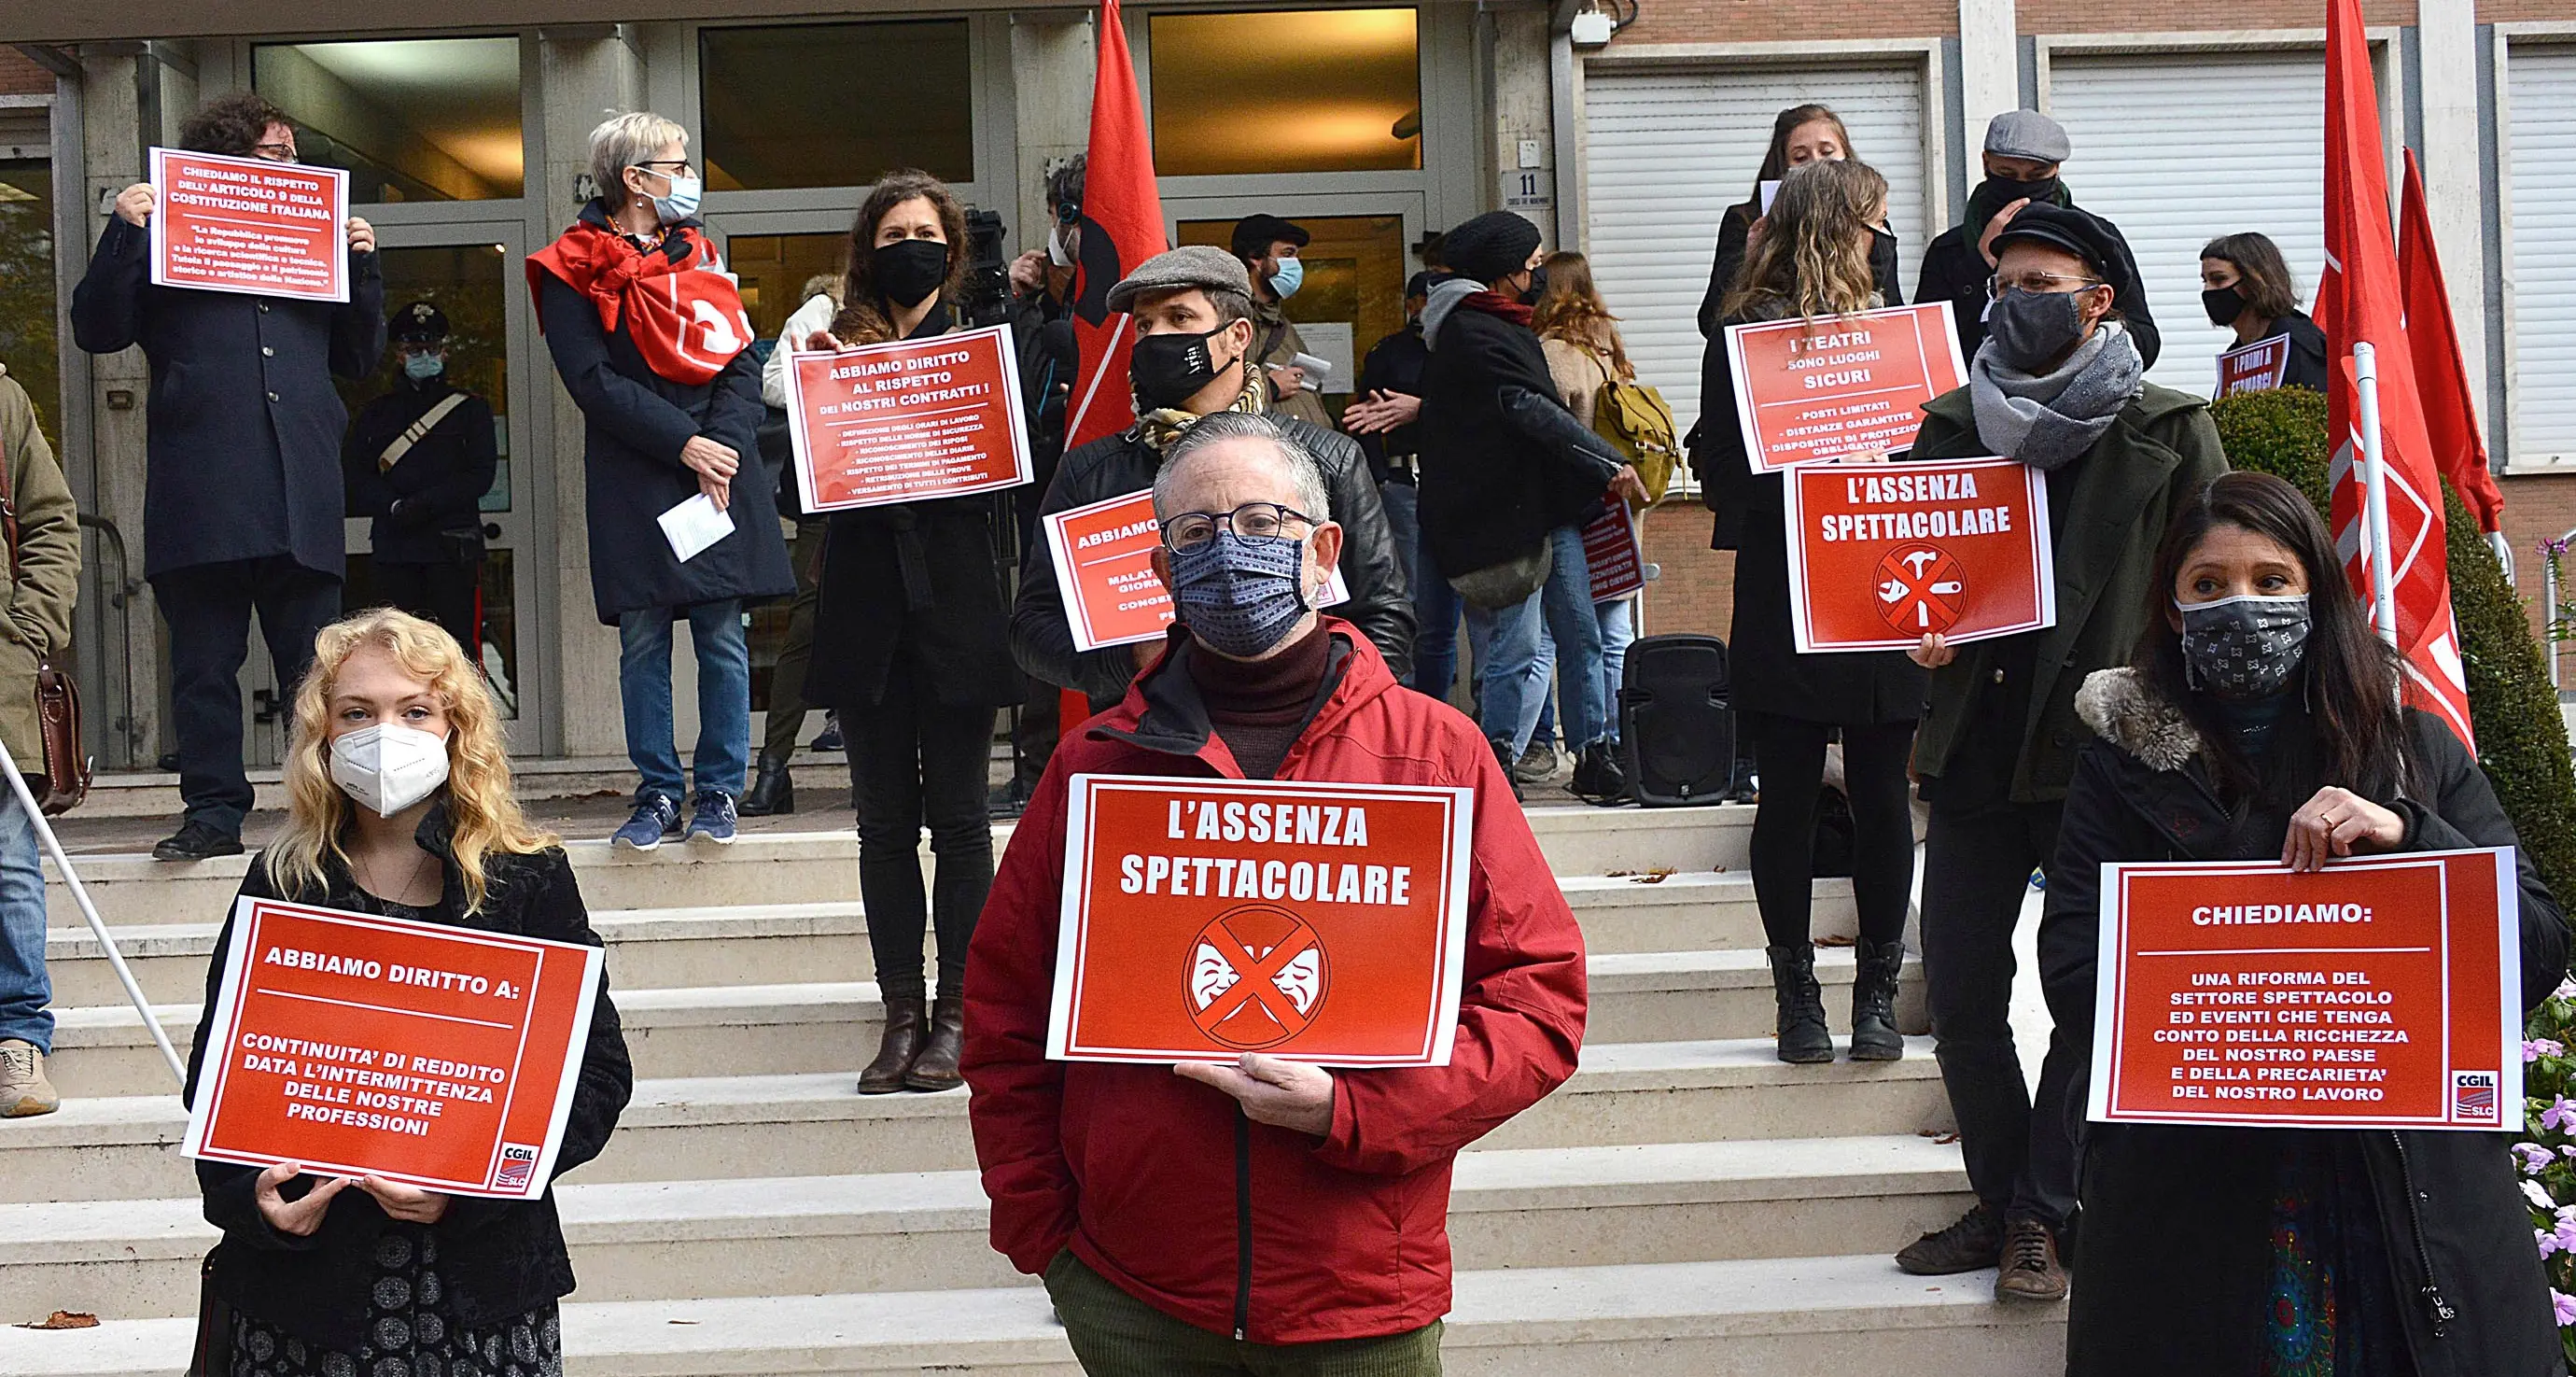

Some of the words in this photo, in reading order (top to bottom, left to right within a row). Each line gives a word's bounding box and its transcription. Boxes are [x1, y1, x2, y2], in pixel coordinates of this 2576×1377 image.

[182, 166, 248, 183] CHIEDIAMO
[250, 174, 262, 185] IL
[263, 176, 319, 191] RISPETTO
[1519, 174, 1536, 195] 11
[208, 182, 276, 200] ARTICOLO
[278, 190, 287, 202] 9
[289, 193, 324, 206] DELLA
[170, 191, 269, 214] COSTITUZIONE
[271, 204, 331, 221] ITALIANA
[194, 236, 205, 245] lo
[206, 238, 246, 249] sviluppo
[247, 242, 272, 251] della
[272, 245, 307, 256] cultura
[209, 227, 262, 240] Repubblica
[263, 234, 310, 246] promuove
[171, 254, 203, 265] Tutela
[203, 257, 211, 266] il
[212, 260, 262, 272] paesaggio
[271, 264, 278, 273] il
[279, 266, 329, 277] patrimonio
[182, 245, 192, 254] la
[193, 246, 229, 258] ricerca
[230, 251, 280, 262] scientifica
[288, 256, 328, 268] tecnica.
[172, 265, 207, 275] storico
[217, 270, 258, 281] artistico
[259, 274, 283, 283] della
[1789, 339, 1798, 353] I
[1801, 330, 1871, 351] TEATRI
[829, 359, 903, 381] ABBIAMO
[906, 350, 970, 371] DIRITTO
[1787, 357, 1826, 371] SONO
[1828, 350, 1881, 365] LUOGHI
[2234, 357, 2238, 374] I
[2239, 348, 2264, 372] PRIMI
[2265, 346, 2272, 365] A
[852, 383, 873, 395] AL
[875, 371, 952, 392] RISPETTO
[1803, 368, 1871, 389] SICURI
[819, 405, 838, 415] DEI
[841, 396, 896, 413] NOSTRI
[899, 384, 981, 406] CONTRATTI
[984, 383, 989, 394] !
[1801, 408, 1838, 420] POSTI
[1839, 400, 1890, 415] LIMITATI
[842, 426, 890, 438] DEFINIZIONE
[890, 423, 915, 432] DEGLI
[915, 420, 939, 429] ORARI
[940, 418, 949, 427] DI
[949, 414, 980, 425] LAVORO
[1785, 422, 1843, 437] DISTANZE
[1845, 411, 1914, 429] GARANTITE
[841, 437, 878, 447] RISPETTO
[878, 434, 903, 443] DELLE
[903, 431, 931, 440] NORME
[942, 423, 985, 436] SICUREZZA
[860, 441, 928, 455] RICONOSCIMENTO
[928, 439, 942, 447] DEI
[942, 435, 968, 445] RIPOSI
[1771, 436, 1842, 453] DISPOSITIVI
[1844, 433, 1858, 443] DI
[856, 451, 923, 465] RICONOSCIMENTO
[924, 448, 948, 457] DELLE
[949, 444, 975, 455] DIARIE
[1813, 439, 1892, 456] OBBLIGATORI
[846, 465, 884, 476] RISPETTO
[898, 460, 931, 470] TERMINI
[941, 452, 987, 465] PAGAMENTO
[864, 471, 921, 484] RETRIBUZIONE
[921, 468, 945, 477] DELLE
[945, 465, 972, 475] PROVE
[851, 483, 903, 496] VERSAMENTO
[913, 479, 937, 487] TUTTI
[942, 471, 988, 485] CONTRIBUTI
[1821, 505, 2011, 541] SPETTACOLARE
[1077, 518, 1159, 550] ABBIAMO
[1108, 568, 1154, 586] MALAT
[1118, 578, 1163, 594] GIORN
[1120, 854, 1410, 906] SPETTACOLARE
[2191, 903, 2372, 926] CHIEDIAMO:
[264, 947, 382, 979] ABBIAMO
[388, 964, 488, 994] DIRITTO
[494, 980, 520, 1000] A:
[2191, 973, 2232, 986] UNA
[2237, 972, 2327, 986] RIFORMA
[2332, 972, 2371, 985] DEL
[2170, 991, 2257, 1005] SETTORE
[2262, 991, 2392, 1005] SPETTACOLO
[2169, 1011, 2194, 1024] ED
[2200, 1010, 2270, 1024] EVENTI
[2276, 1010, 2317, 1023] CHE
[2322, 1010, 2393, 1024] TENGA
[2153, 1029, 2219, 1043] CONTO
[2225, 1029, 2288, 1043] DELLA
[2293, 1029, 2409, 1043] RICCHEZZA
[244, 1054, 297, 1076] DATA
[2183, 1048, 2219, 1061] DEL
[2225, 1048, 2306, 1061] NOSTRO
[2312, 1048, 2375, 1062] PAESE
[383, 1052, 407, 1070] DI
[411, 1056, 505, 1084] REDDITO
[2171, 1067, 2183, 1080] E
[2189, 1067, 2251, 1081] DELLA
[2457, 1075, 2494, 1087] CGIL
[284, 1080, 352, 1104] DELLE
[356, 1090, 443, 1117] NOSTRE
[2172, 1085, 2209, 1099] DEL
[2215, 1086, 2296, 1101] NOSTRO
[2303, 1087, 2384, 1101] LAVORO
[287, 1103, 429, 1136] PROFESSIONI
[2471, 1106, 2493, 1116] SLC
[505, 1147, 533, 1160] CGIL
[508, 1176, 525, 1187] SLC
